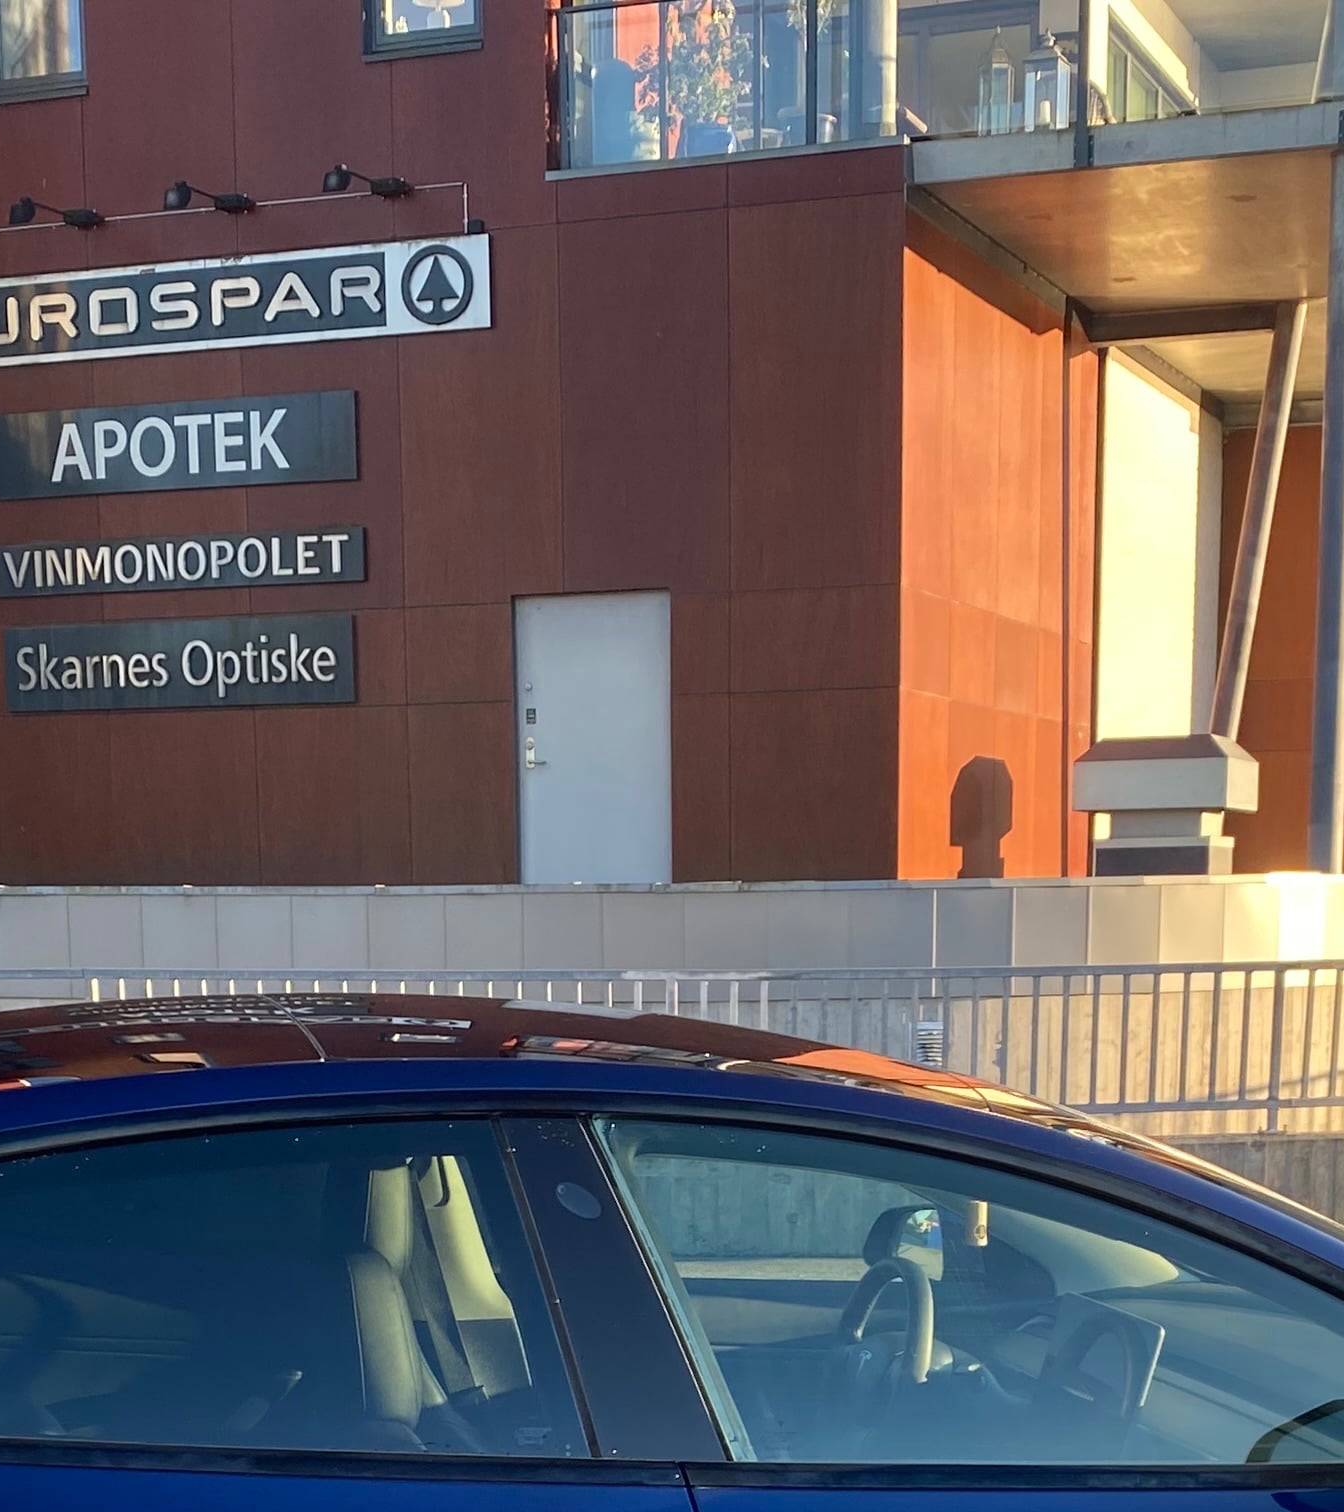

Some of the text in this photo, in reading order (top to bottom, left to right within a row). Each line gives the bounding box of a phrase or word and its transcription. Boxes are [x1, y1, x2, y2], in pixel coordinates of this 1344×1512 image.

[51, 407, 290, 483] APOTEK
[3, 534, 349, 588] VINMONOPOLET
[15, 632, 338, 698] Skarnes Optiske
